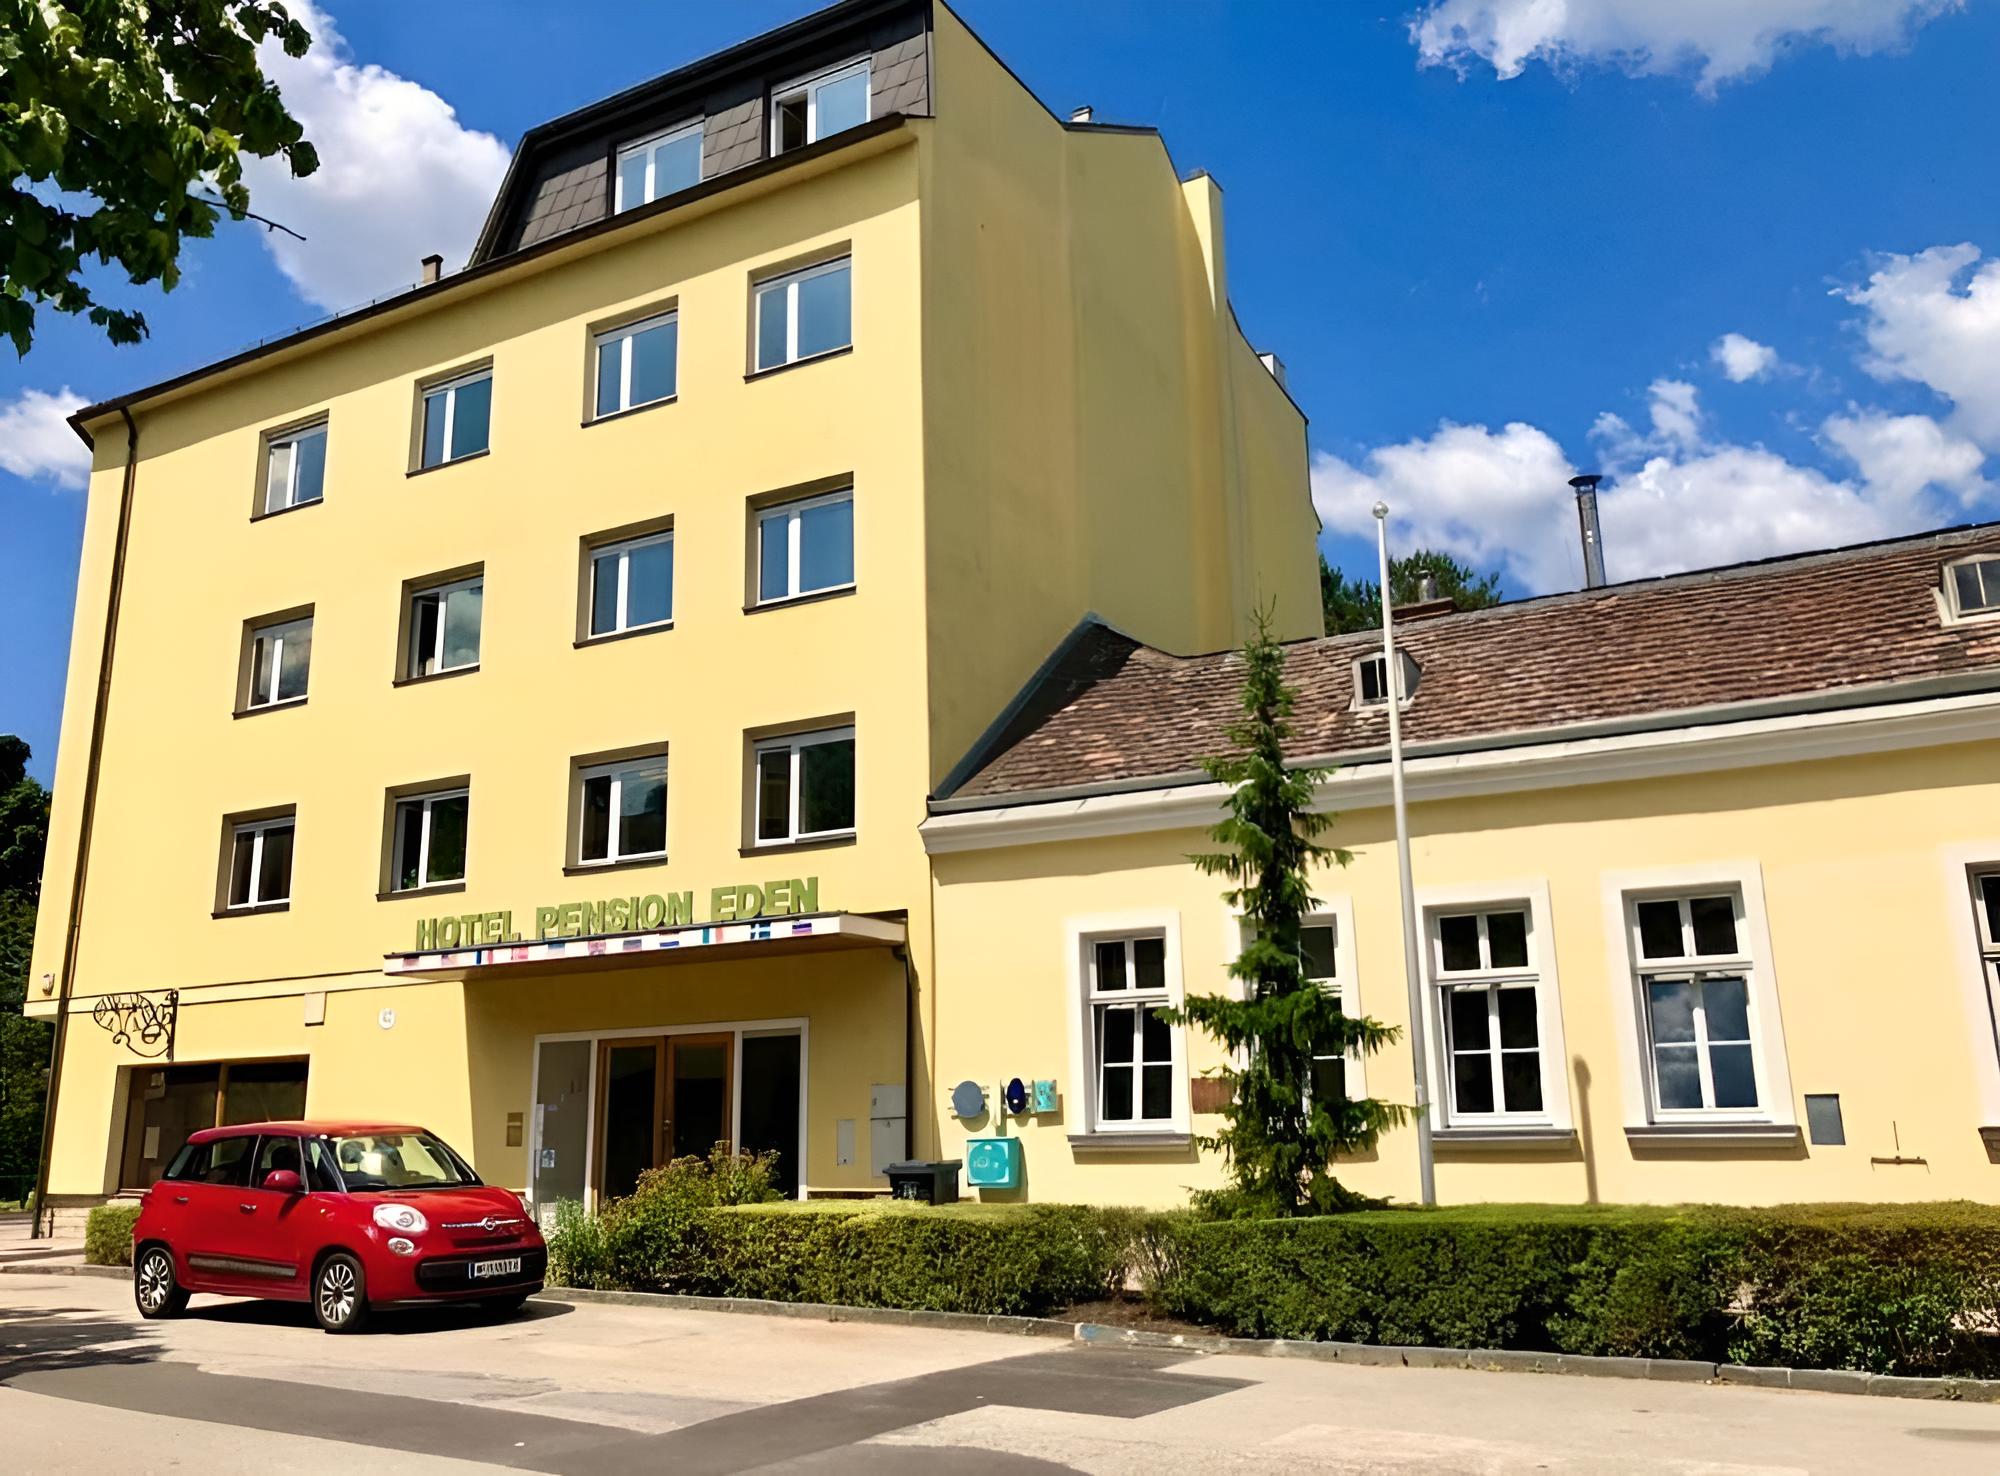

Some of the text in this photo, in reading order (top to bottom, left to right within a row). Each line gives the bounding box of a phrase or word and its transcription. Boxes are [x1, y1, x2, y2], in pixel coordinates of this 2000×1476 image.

[416, 876, 819, 952] HOTEL PENSION EDEN
